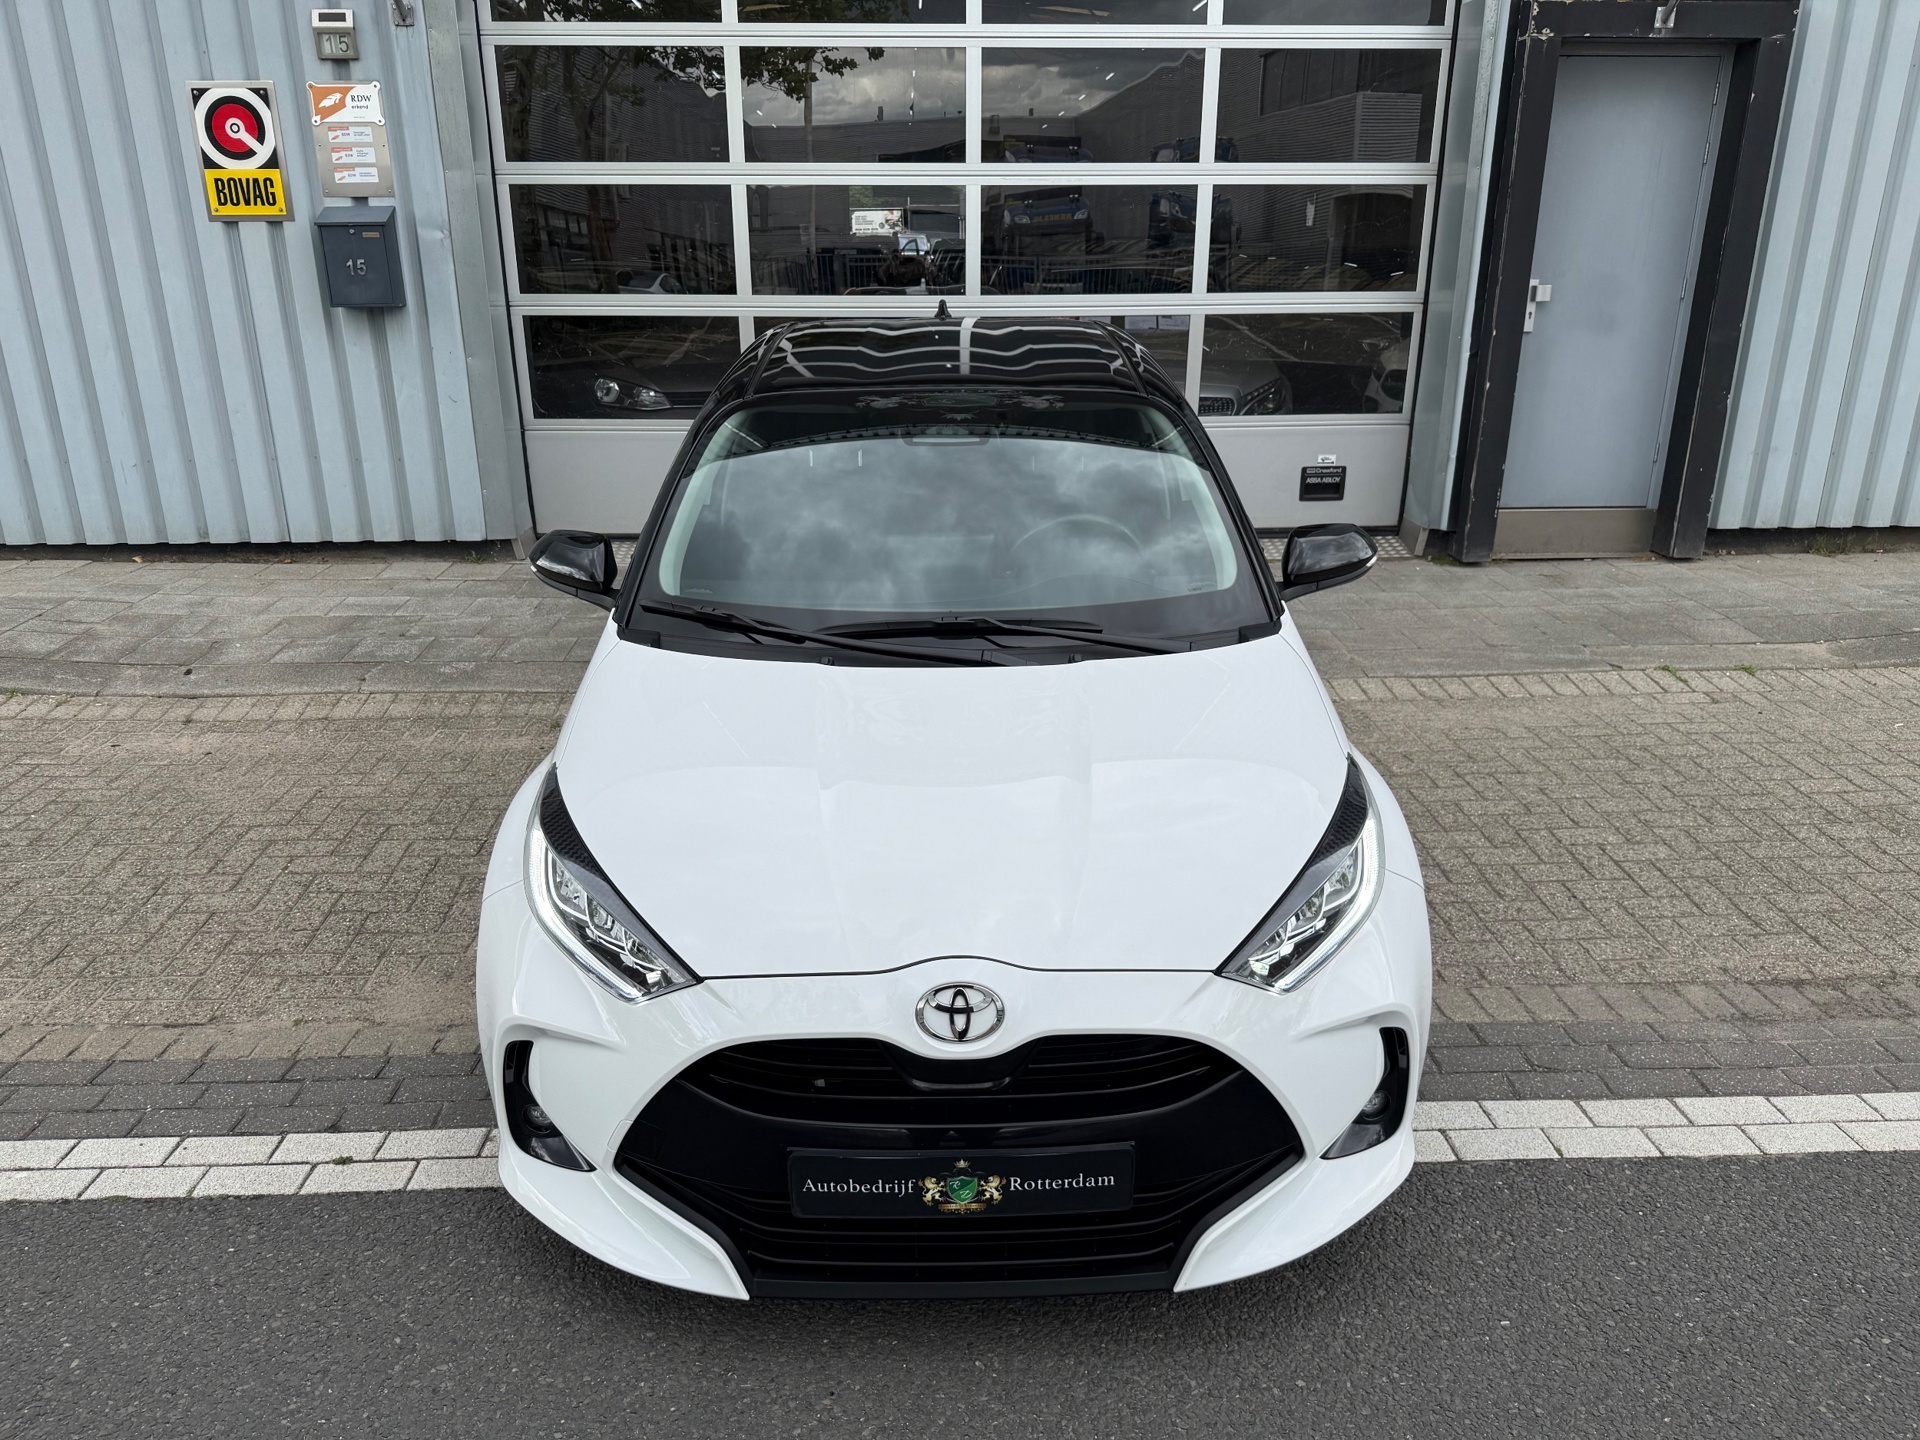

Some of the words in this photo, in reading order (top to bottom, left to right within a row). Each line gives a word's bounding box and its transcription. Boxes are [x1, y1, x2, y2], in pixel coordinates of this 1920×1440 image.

[325, 35, 349, 53] 15
[350, 94, 372, 103] RDW
[213, 177, 277, 207] BOVAG
[346, 259, 367, 276] 15
[802, 1179, 916, 1198] Autobedrijf
[1009, 1173, 1115, 1191] Rotterdam
